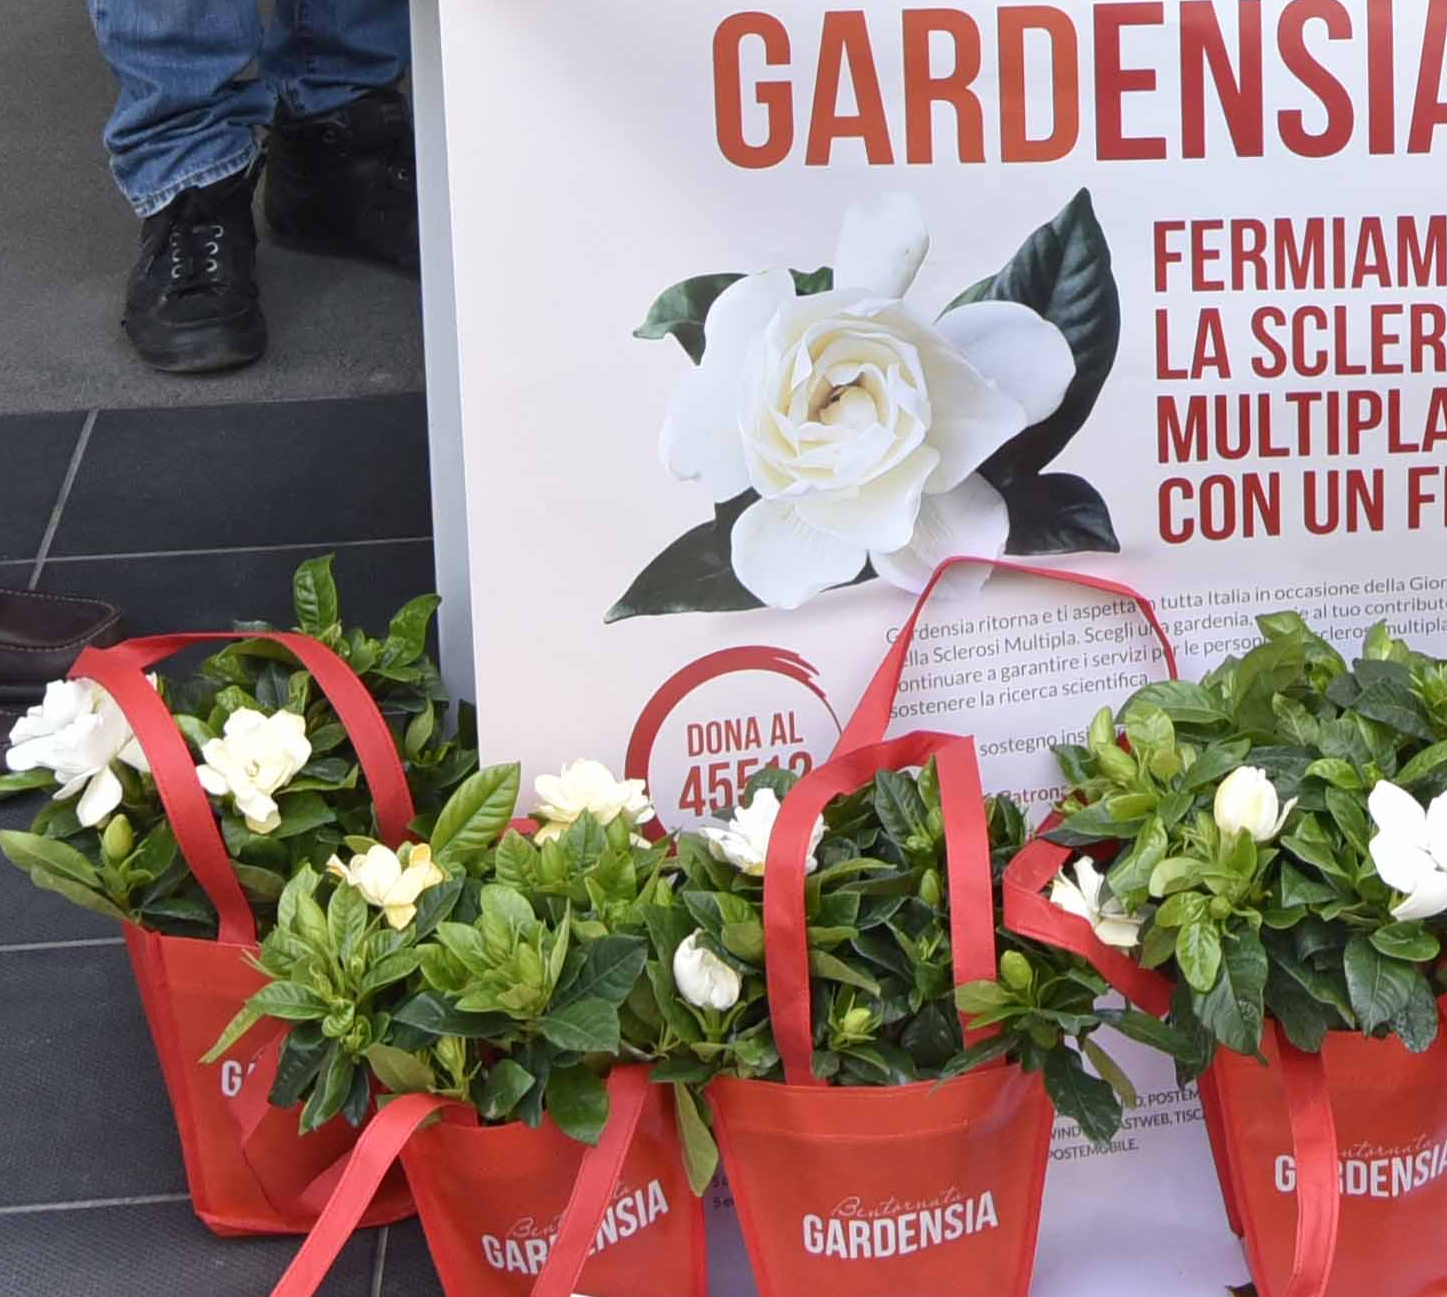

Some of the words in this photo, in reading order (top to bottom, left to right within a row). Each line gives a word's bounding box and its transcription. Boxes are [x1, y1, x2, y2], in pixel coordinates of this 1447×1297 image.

[1156, 307, 1232, 379] LA
[1159, 472, 1281, 543] CON
[1304, 469, 1386, 534] UN
[933, 638, 1000, 664] Sclerosi
[1004, 632, 1082, 657] Multipla.
[1084, 622, 1135, 647] Scegli
[1313, 604, 1328, 620] al
[1332, 601, 1360, 617] tuo
[978, 612, 1040, 634] ritorna
[1042, 611, 1053, 624] e
[1056, 604, 1070, 623] ti
[1072, 599, 1136, 624] aspetta
[1160, 593, 1203, 610] tutta
[1207, 588, 1251, 605] Italia
[1254, 586, 1271, 602] in
[1274, 581, 1360, 600] occasione
[1364, 577, 1405, 594] della
[897, 666, 983, 694] ontinuare
[986, 668, 997, 681] a
[1000, 657, 1080, 683] garantire
[1083, 655, 1088, 669] i
[1091, 648, 1150, 668] servizi
[1184, 639, 1200, 655] le
[979, 690, 995, 707] la
[999, 684, 1058, 705] ricerca
[686, 716, 762, 757] DONA
[770, 711, 803, 747] AL
[978, 733, 1057, 759] sostegno
[482, 1179, 669, 1275] GARNSIA
[803, 1190, 998, 1259] GARDENSIA
[831, 1187, 968, 1218] Bentornata
